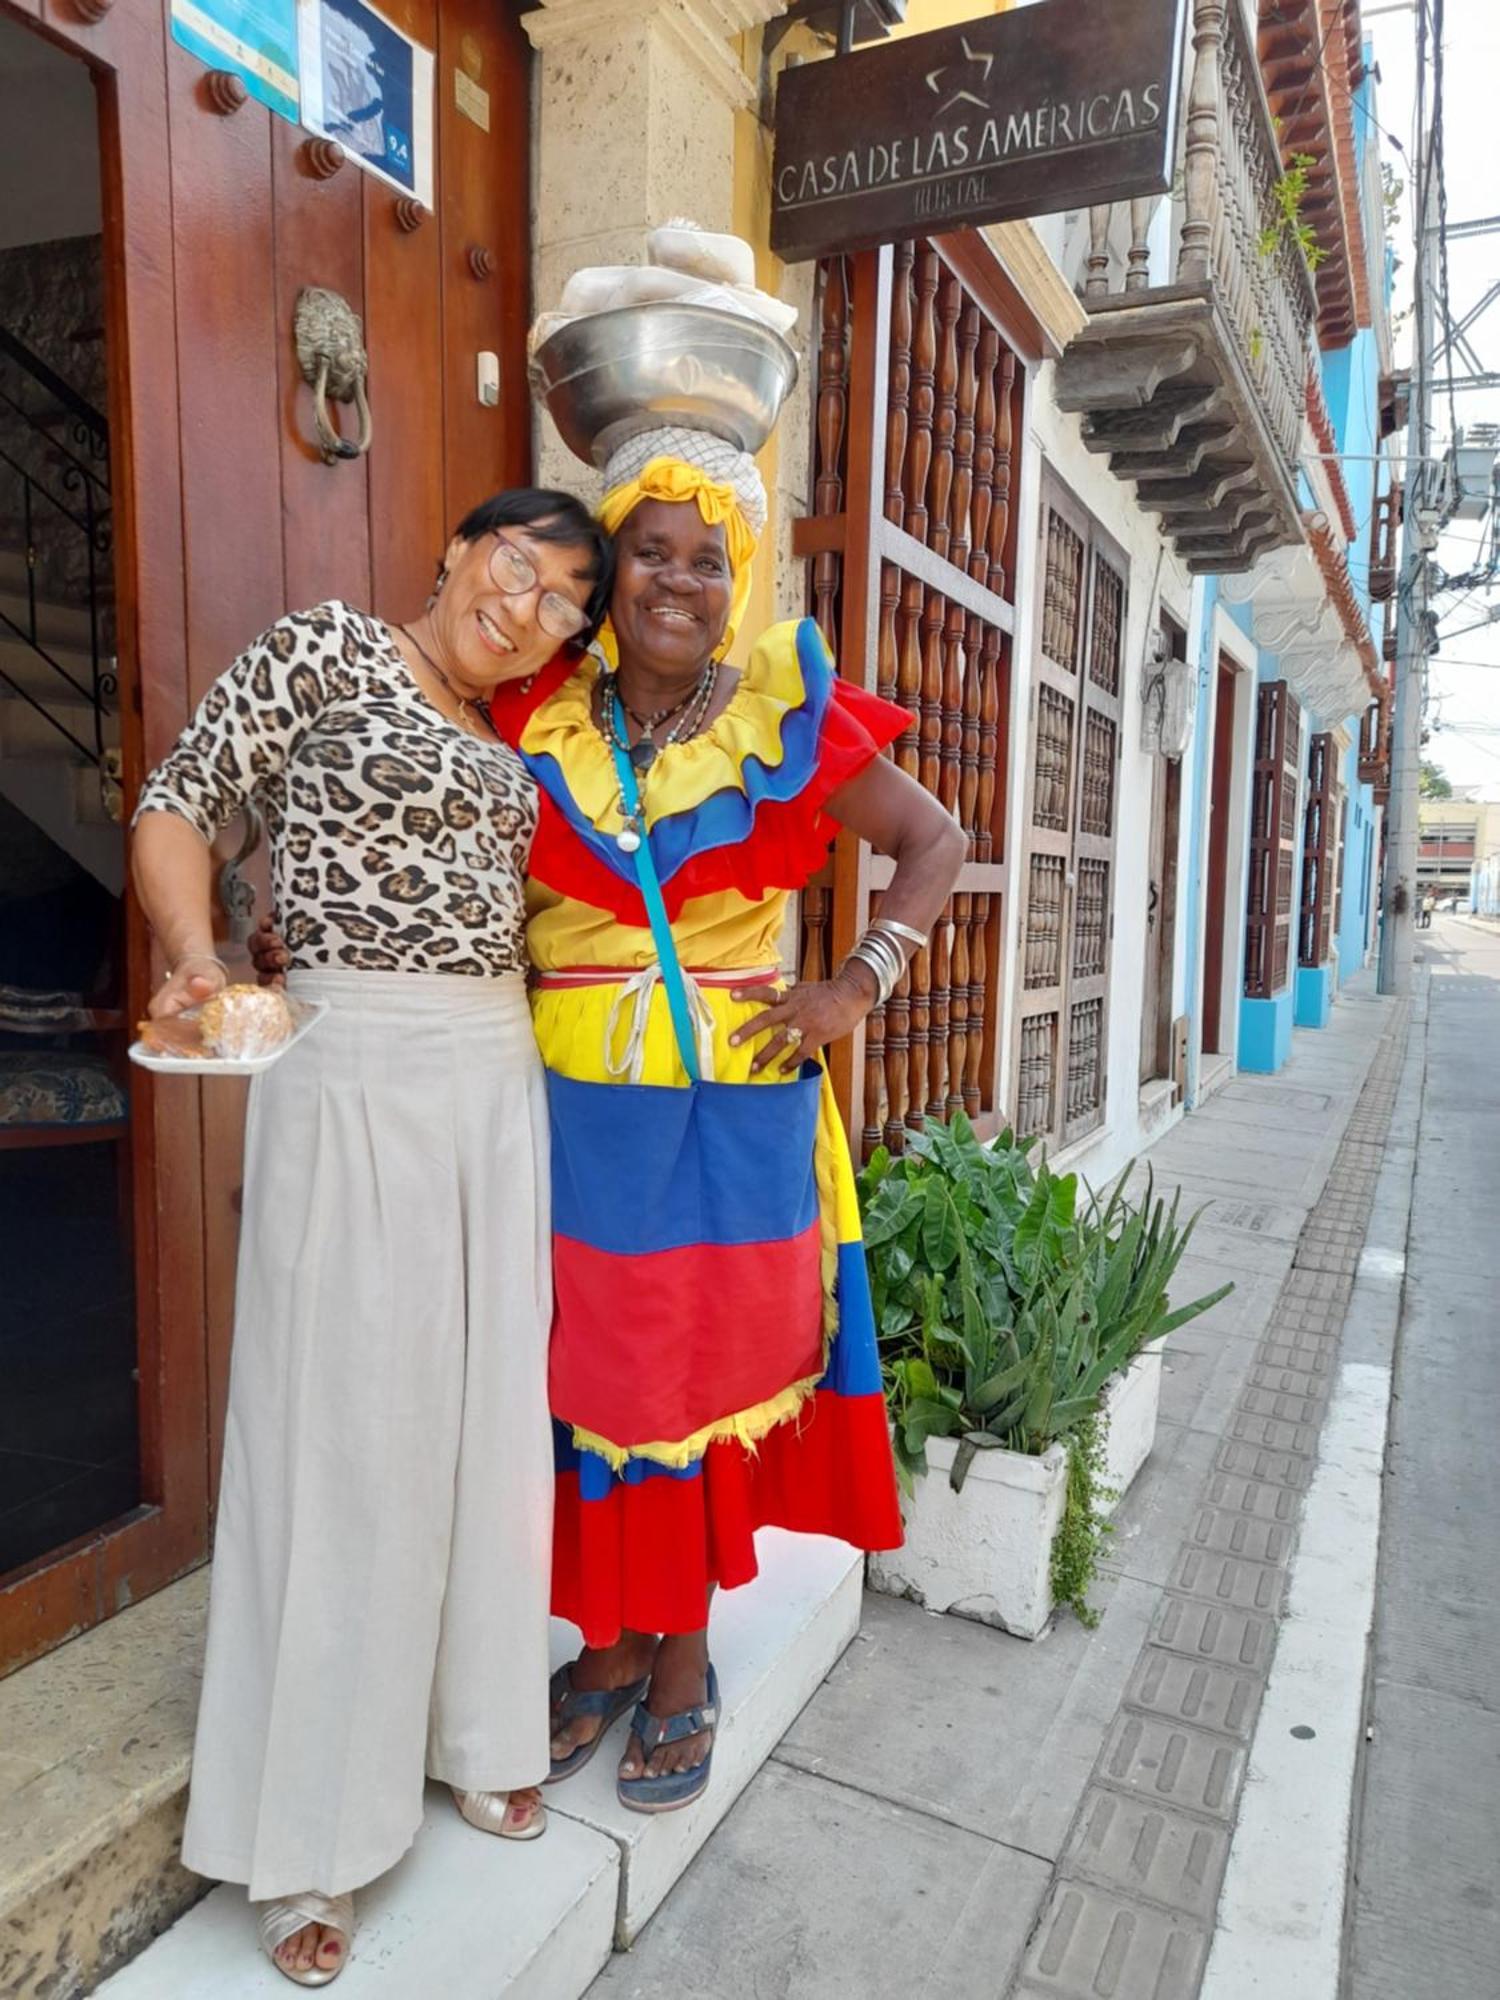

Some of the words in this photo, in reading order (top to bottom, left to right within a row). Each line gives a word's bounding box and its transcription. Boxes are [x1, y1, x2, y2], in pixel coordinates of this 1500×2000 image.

[777, 150, 860, 203] CASA
[868, 140, 903, 185] DE
[912, 125, 969, 175] LAS
[977, 83, 1161, 160] AMÉRICAS
